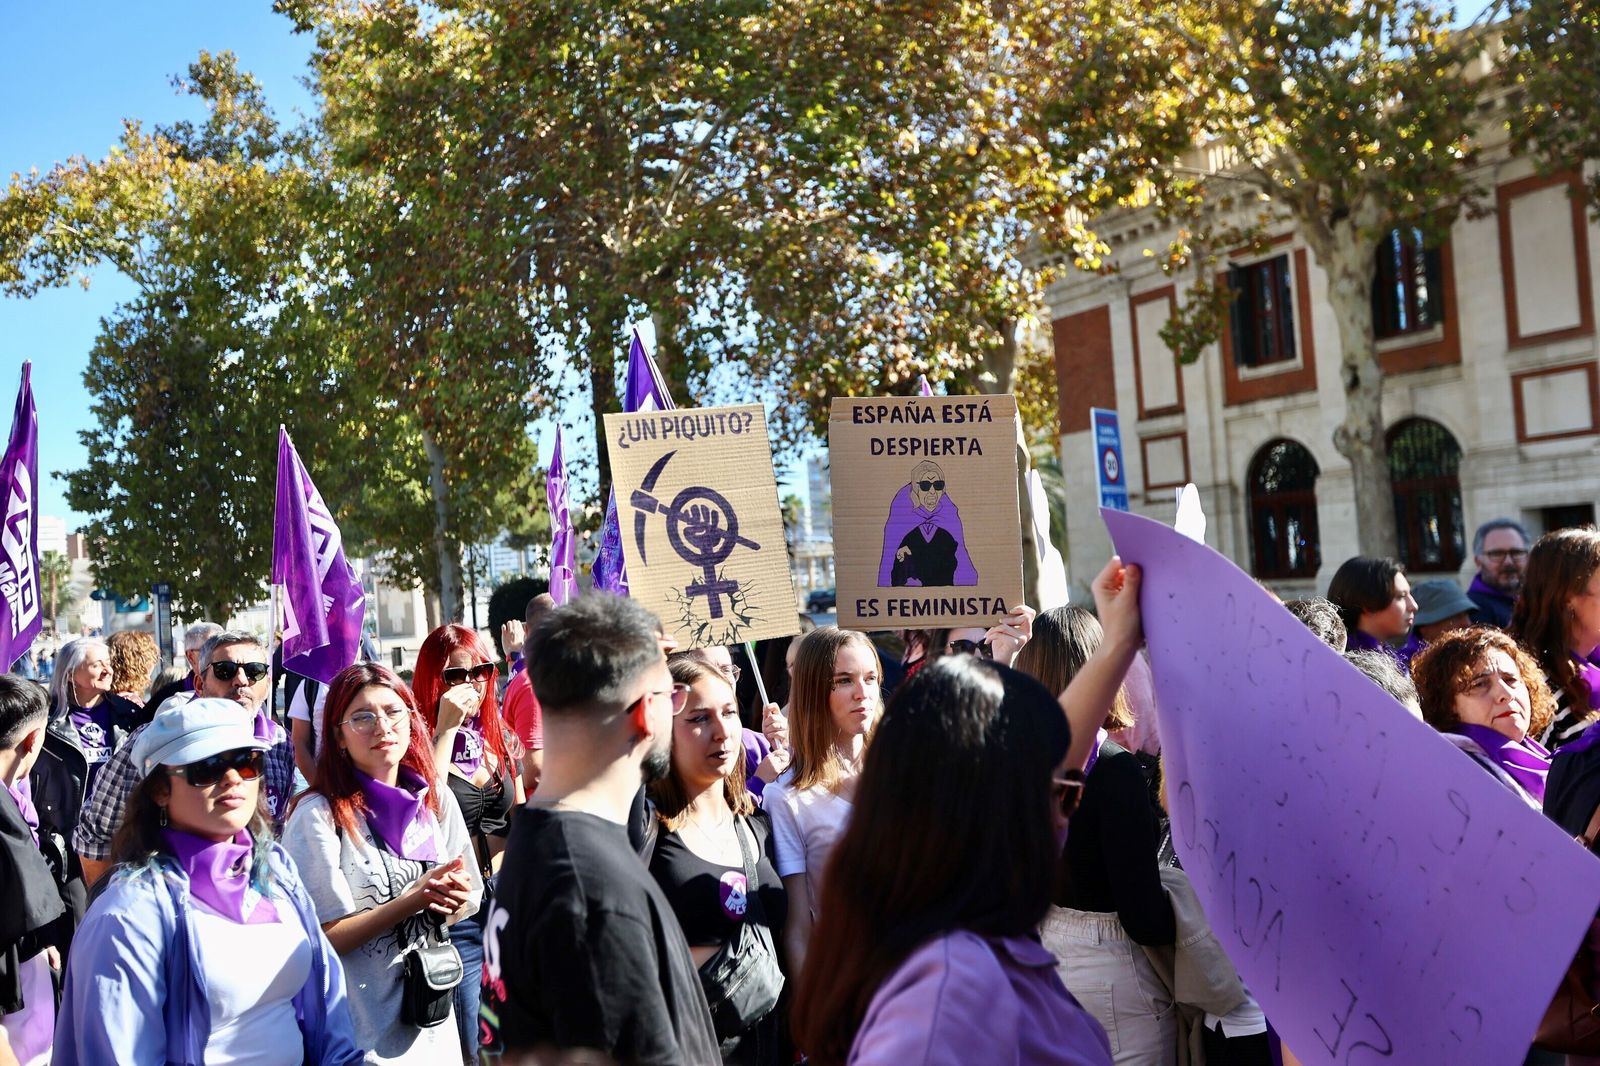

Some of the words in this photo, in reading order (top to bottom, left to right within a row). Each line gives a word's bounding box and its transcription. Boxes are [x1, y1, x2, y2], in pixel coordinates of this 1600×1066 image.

[852, 401, 936, 425] ESPAÑA
[942, 400, 993, 423] ESTÁ
[618, 419, 657, 449] ¿UN
[661, 412, 753, 441] PIQUITO?
[870, 437, 983, 457] DESPIERTA
[855, 599, 880, 617] ES
[887, 598, 1008, 617] FEMINISTA
